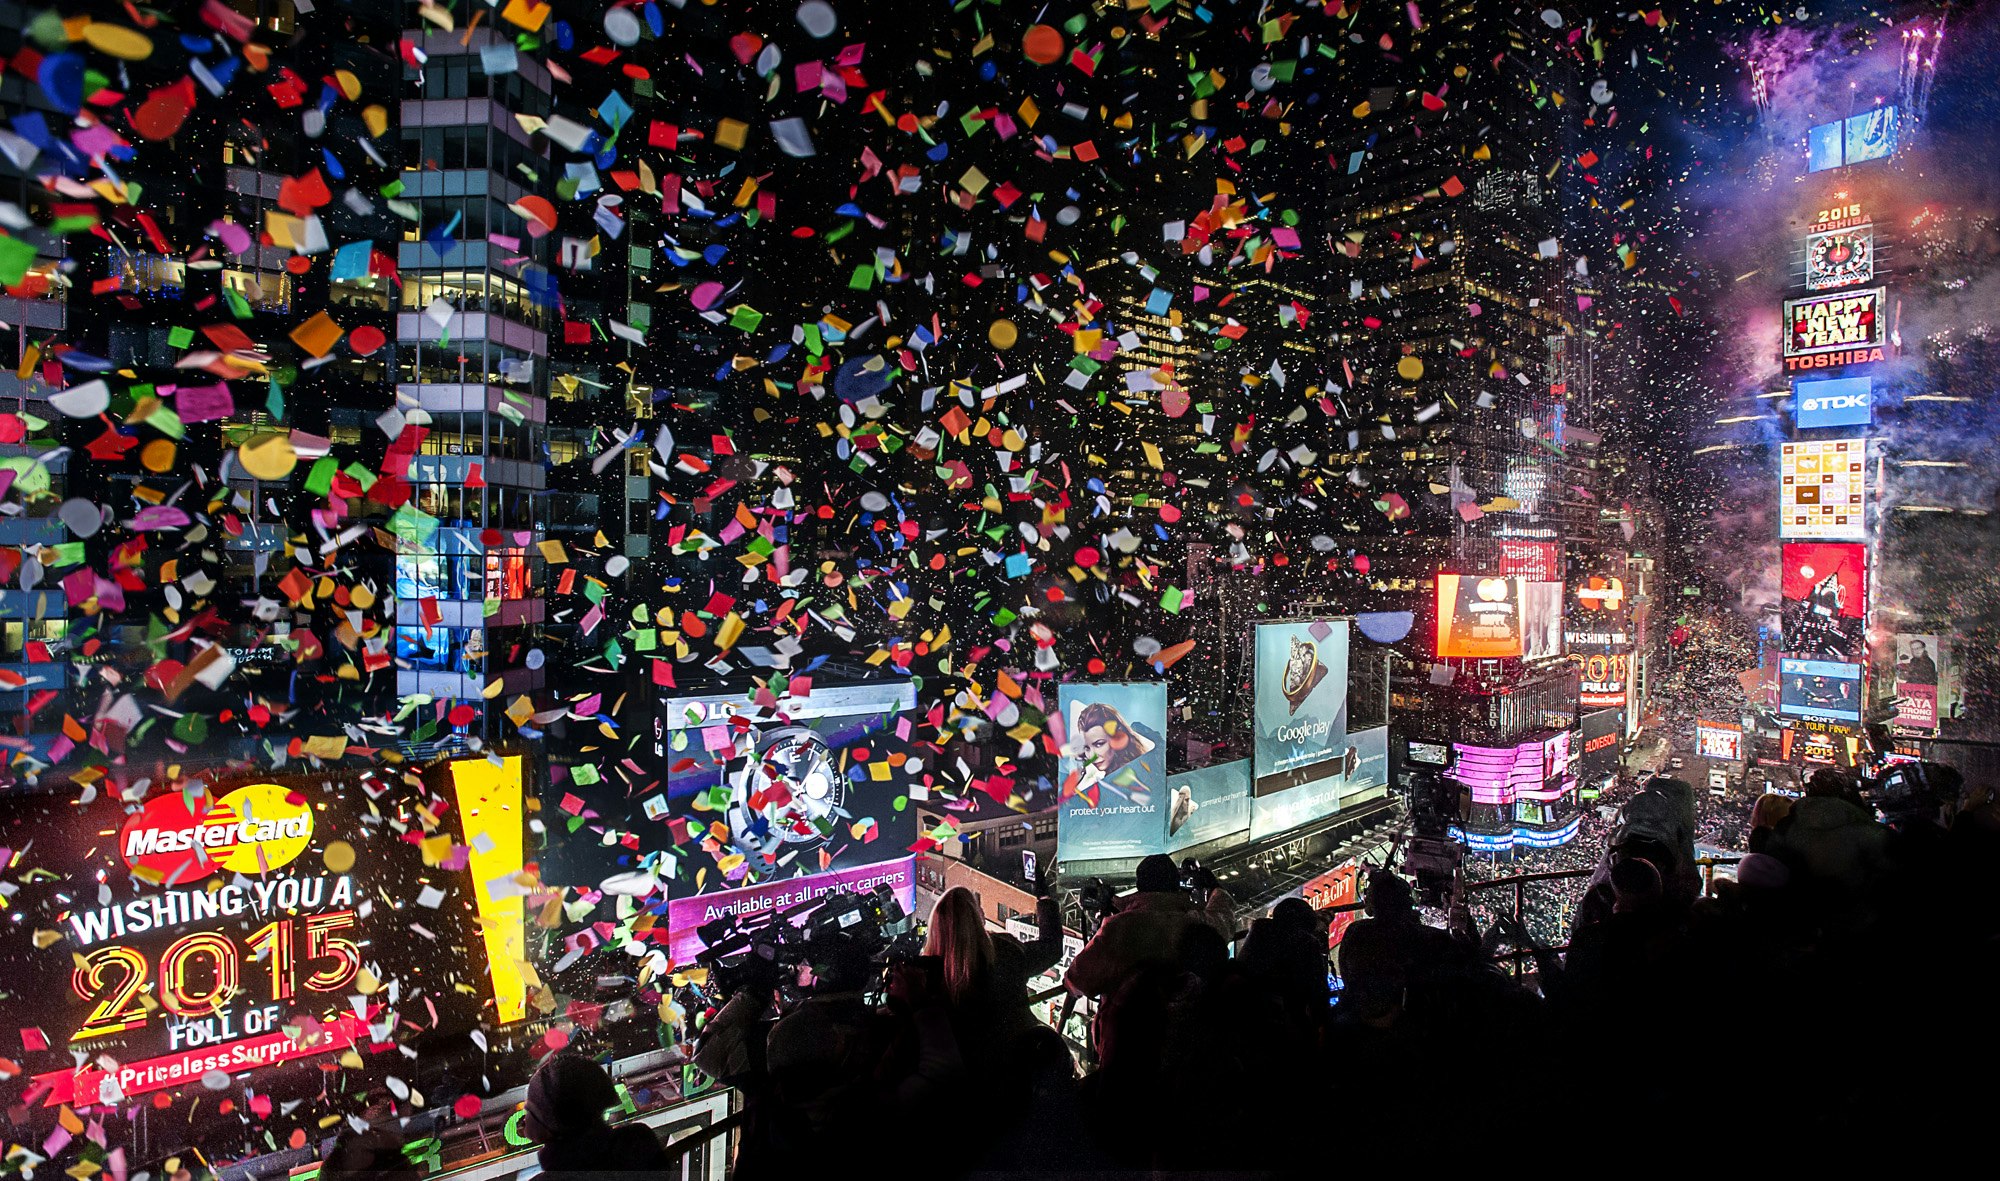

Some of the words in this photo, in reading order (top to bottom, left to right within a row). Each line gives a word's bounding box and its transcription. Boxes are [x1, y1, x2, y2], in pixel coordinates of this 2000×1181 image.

[1808, 214, 1872, 234] TOSHIBA
[1818, 203, 1861, 223] 2015
[1795, 294, 1875, 320] HAPPY
[1807, 311, 1862, 333] NEW
[1799, 324, 1868, 348] YEAR!
[1785, 348, 1885, 370] TOSHIBA
[1817, 393, 1867, 410] TDK
[1564, 631, 1611, 644] WISHING
[1582, 682, 1609, 692] FULL
[1899, 688, 1933, 700] NYC'S
[1802, 715, 1837, 724] SONY
[1898, 706, 1932, 716] STRONG
[1277, 720, 1312, 744] Google
[1312, 718, 1331, 738] play
[1805, 722, 1825, 732] YOUR
[1805, 745, 1835, 757] 2015
[1069, 807, 1099, 818] protect
[1099, 806, 1119, 817] your
[1119, 804, 1140, 814] heart
[1141, 804, 1156, 813] out
[125, 812, 311, 857] MasterCard
[704, 893, 773, 922] Available
[776, 891, 792, 907] at
[794, 885, 811, 903] all
[856, 871, 905, 891] carriers
[1330, 874, 1351, 902] GIFT
[69, 884, 243, 945] WISHING
[253, 876, 324, 911] YOU
[330, 876, 353, 906] A
[70, 909, 361, 1041] 2015
[169, 1008, 238, 1050] FULL
[244, 1005, 279, 1034] OF
[101, 1029, 333, 1090] #PricelessSurpris
